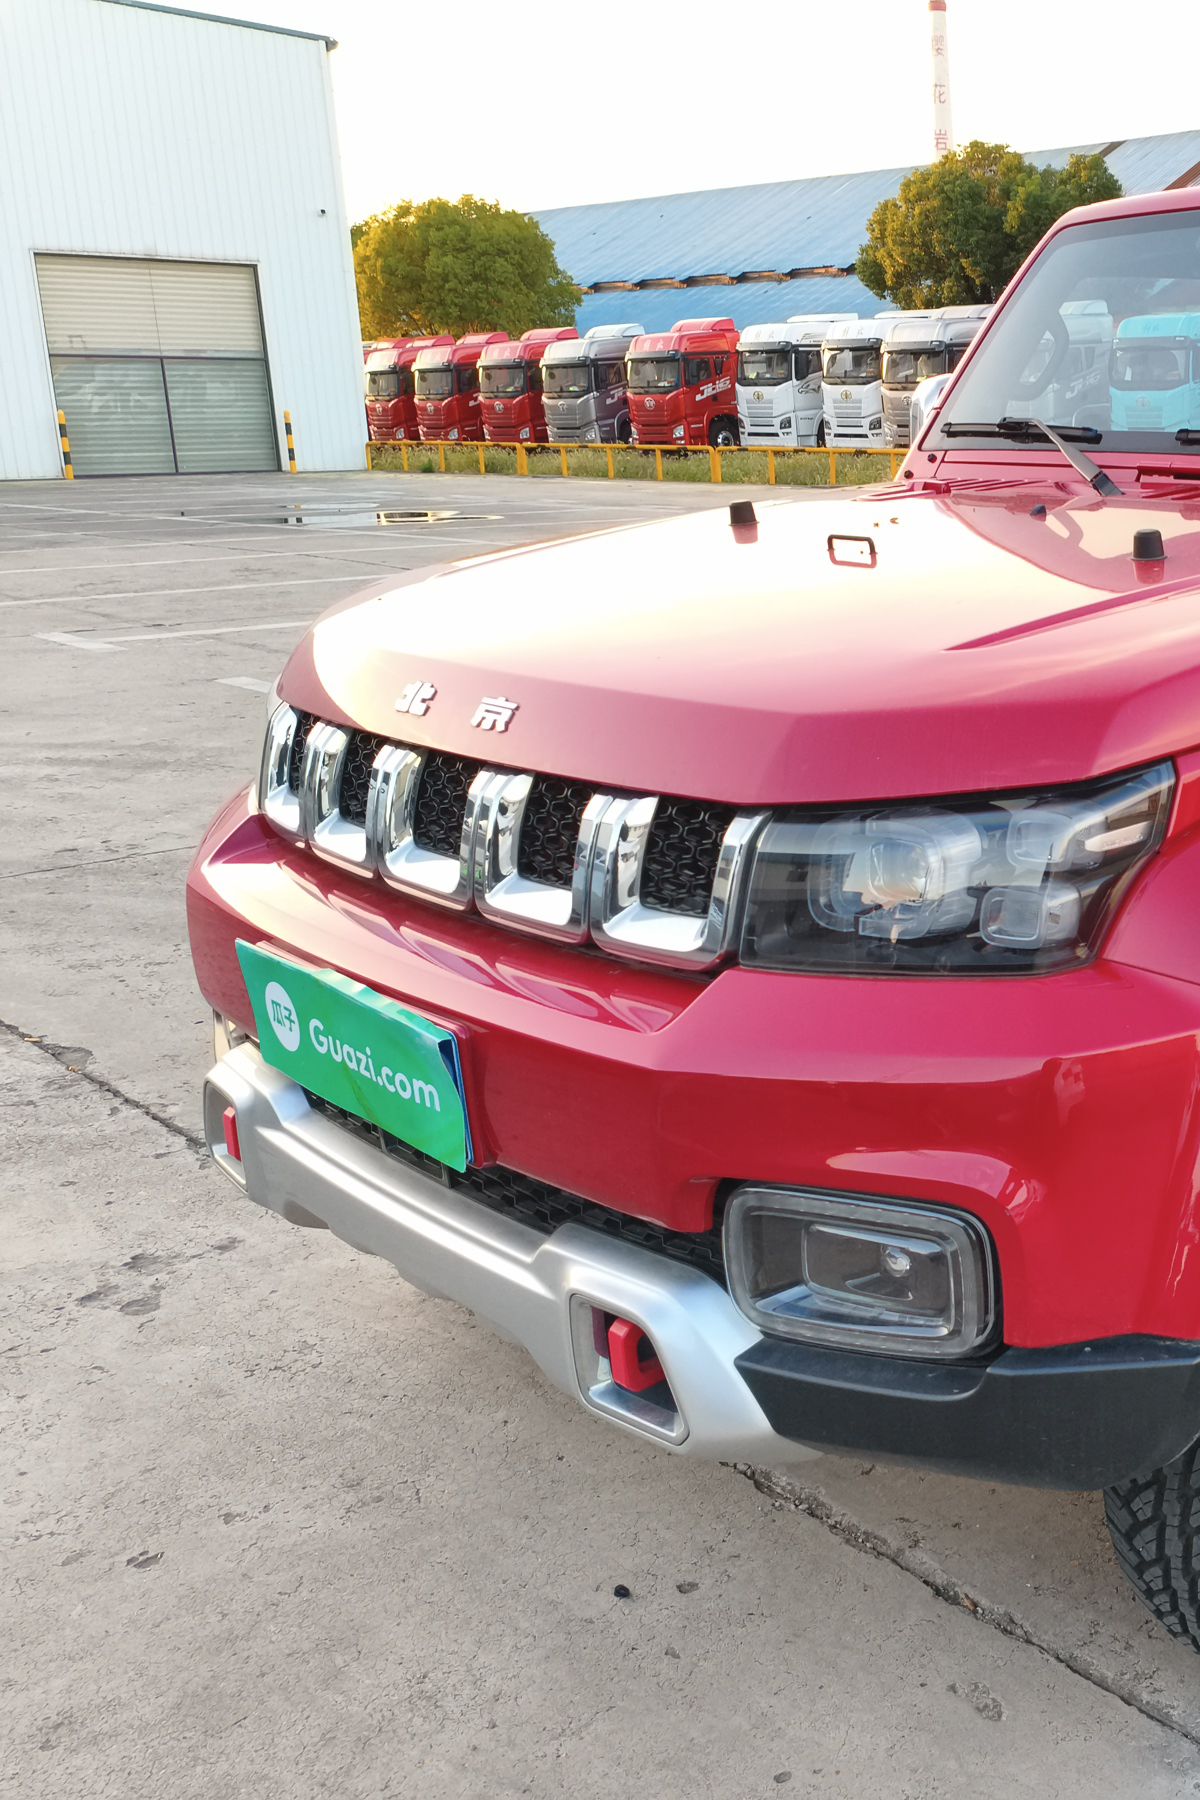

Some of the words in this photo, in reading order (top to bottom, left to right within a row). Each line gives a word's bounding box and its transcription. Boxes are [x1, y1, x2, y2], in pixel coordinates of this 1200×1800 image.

[393, 679, 520, 733] 北京
[271, 999, 295, 1032] 瓜子
[309, 1018, 441, 1112] Guazi.com
